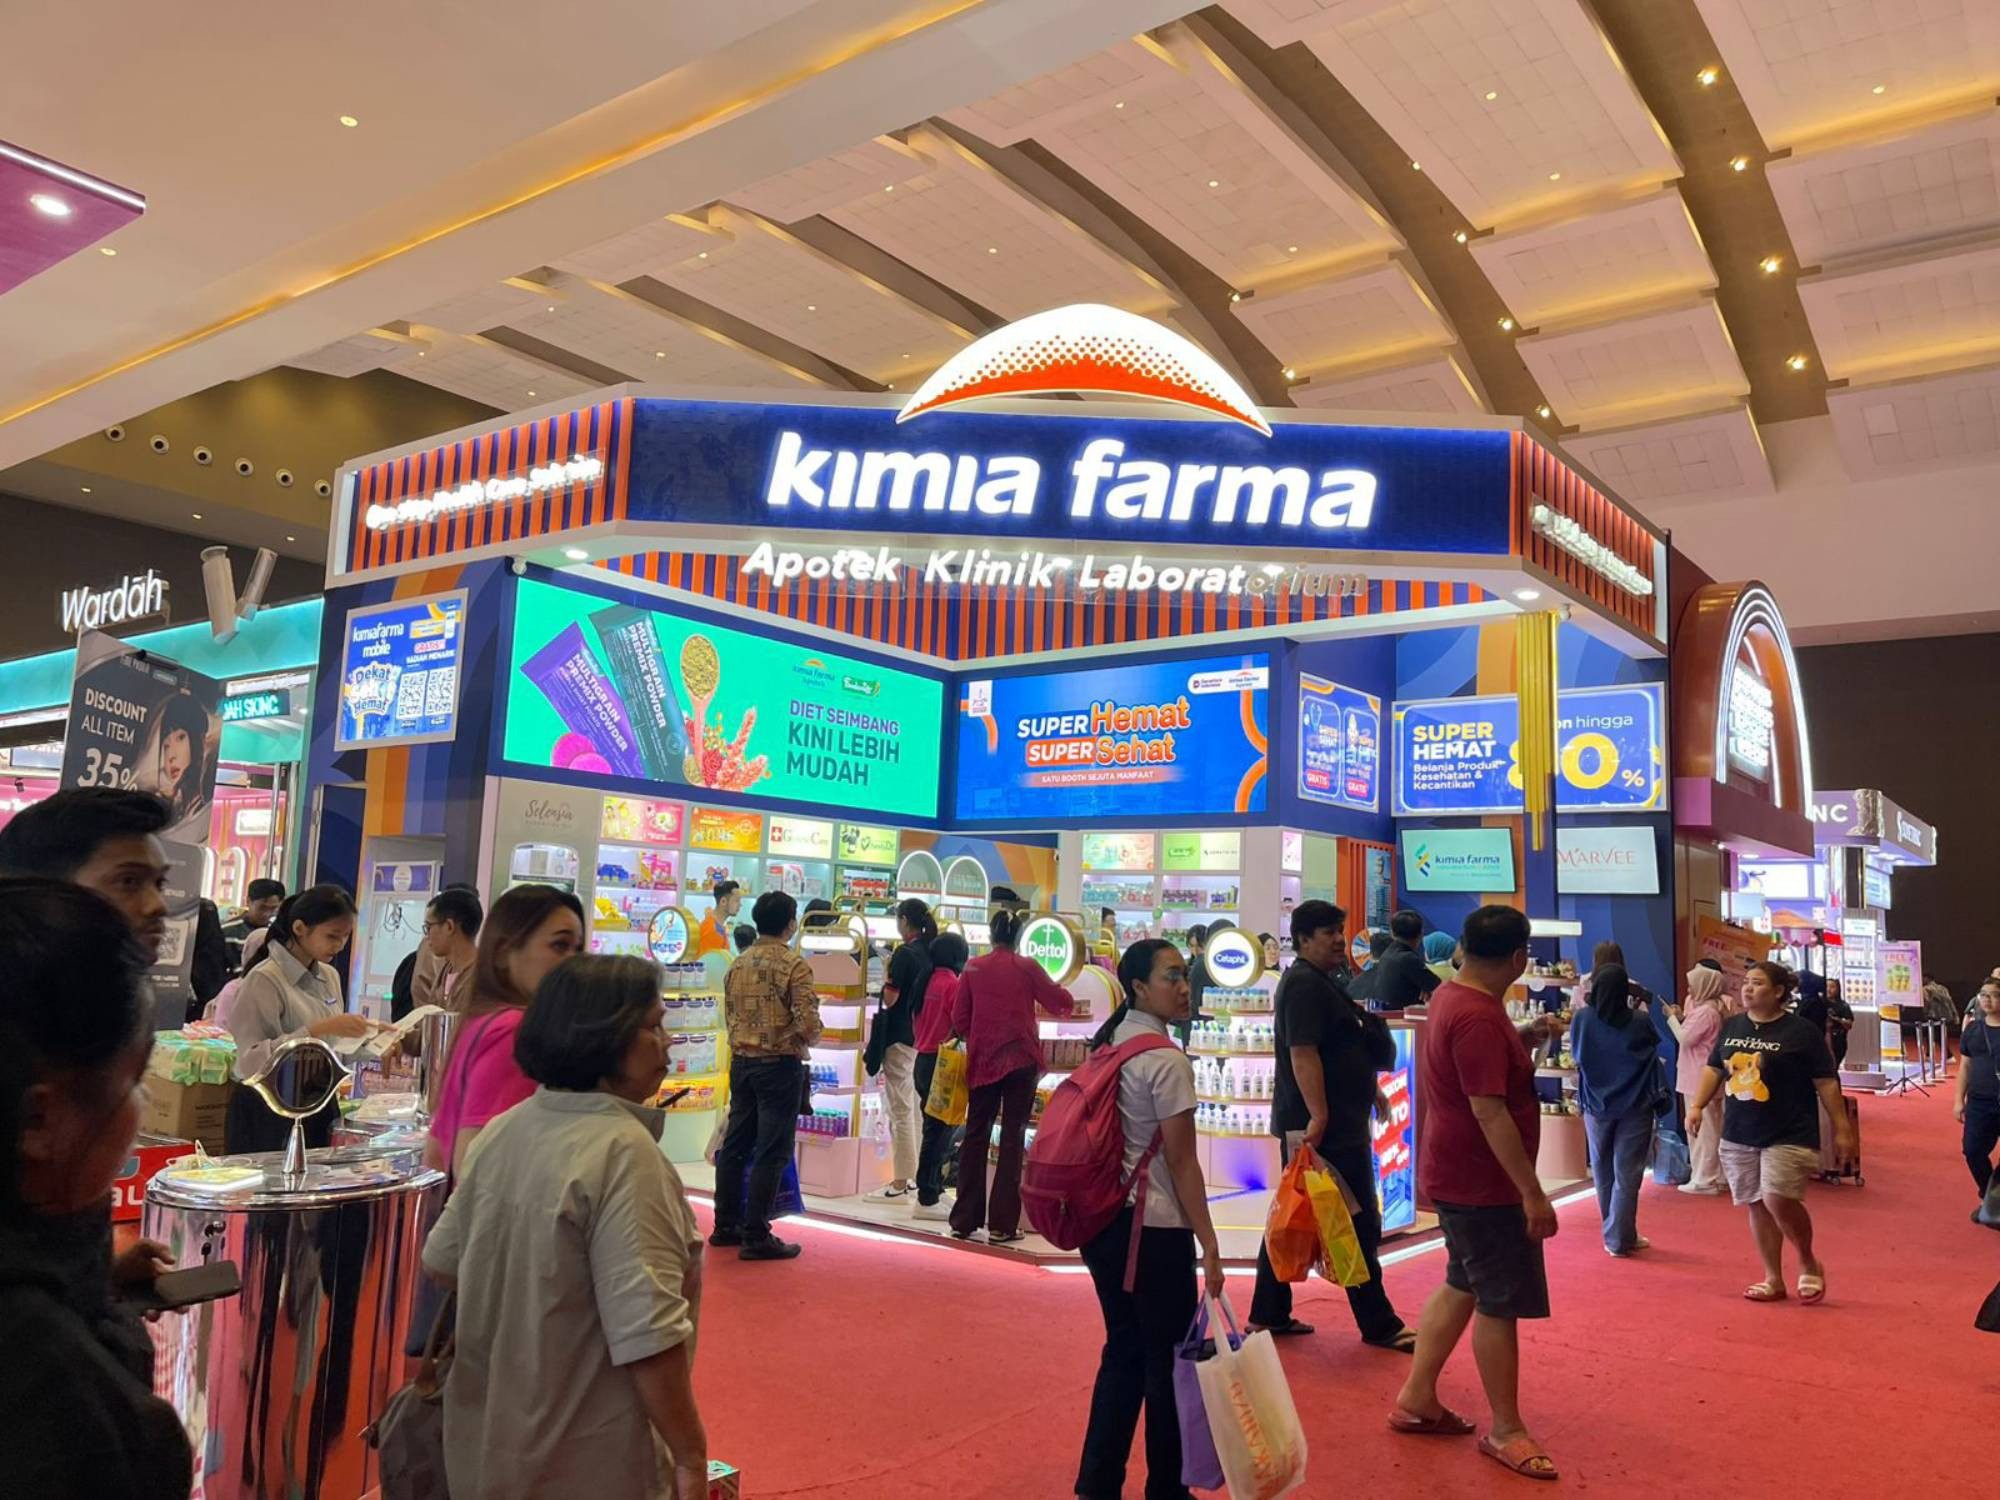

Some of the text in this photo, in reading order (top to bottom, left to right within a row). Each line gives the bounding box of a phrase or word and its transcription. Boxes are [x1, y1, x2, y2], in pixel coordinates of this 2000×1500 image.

[766, 431, 1378, 529] kimia farma
[741, 541, 1368, 596] Apotek Klinik Laboratorium
[362, 640, 391, 657] mobile
[636, 621, 666, 699] MULTIGRAIN
[573, 653, 621, 722] MULTIGRAIN
[628, 624, 666, 729] PREMIX POWDER
[85, 688, 147, 723] DISCOUNT
[565, 660, 629, 752] PREMIX POWDER
[790, 700, 900, 736] DIET SEIMBANG
[1017, 695, 1191, 738] SUPER Hemat
[1576, 715, 1633, 731] hingga
[81, 715, 135, 744] ALL ITEM
[789, 721, 900, 763] KINI LEBIH
[1413, 722, 1494, 742] SUPER
[1028, 731, 1175, 765] SUPER Sehat
[1413, 741, 1496, 760] HEMAT
[77, 748, 138, 791] 35%
[787, 750, 868, 786] MUDAH
[1413, 761, 1499, 774] Belanja Produk
[1413, 771, 1482, 782] Kesehatan &
[1413, 779, 1475, 790] Kecantikan
[1435, 854, 1500, 864] kimia farma
[1028, 940, 1067, 959] Dettol
